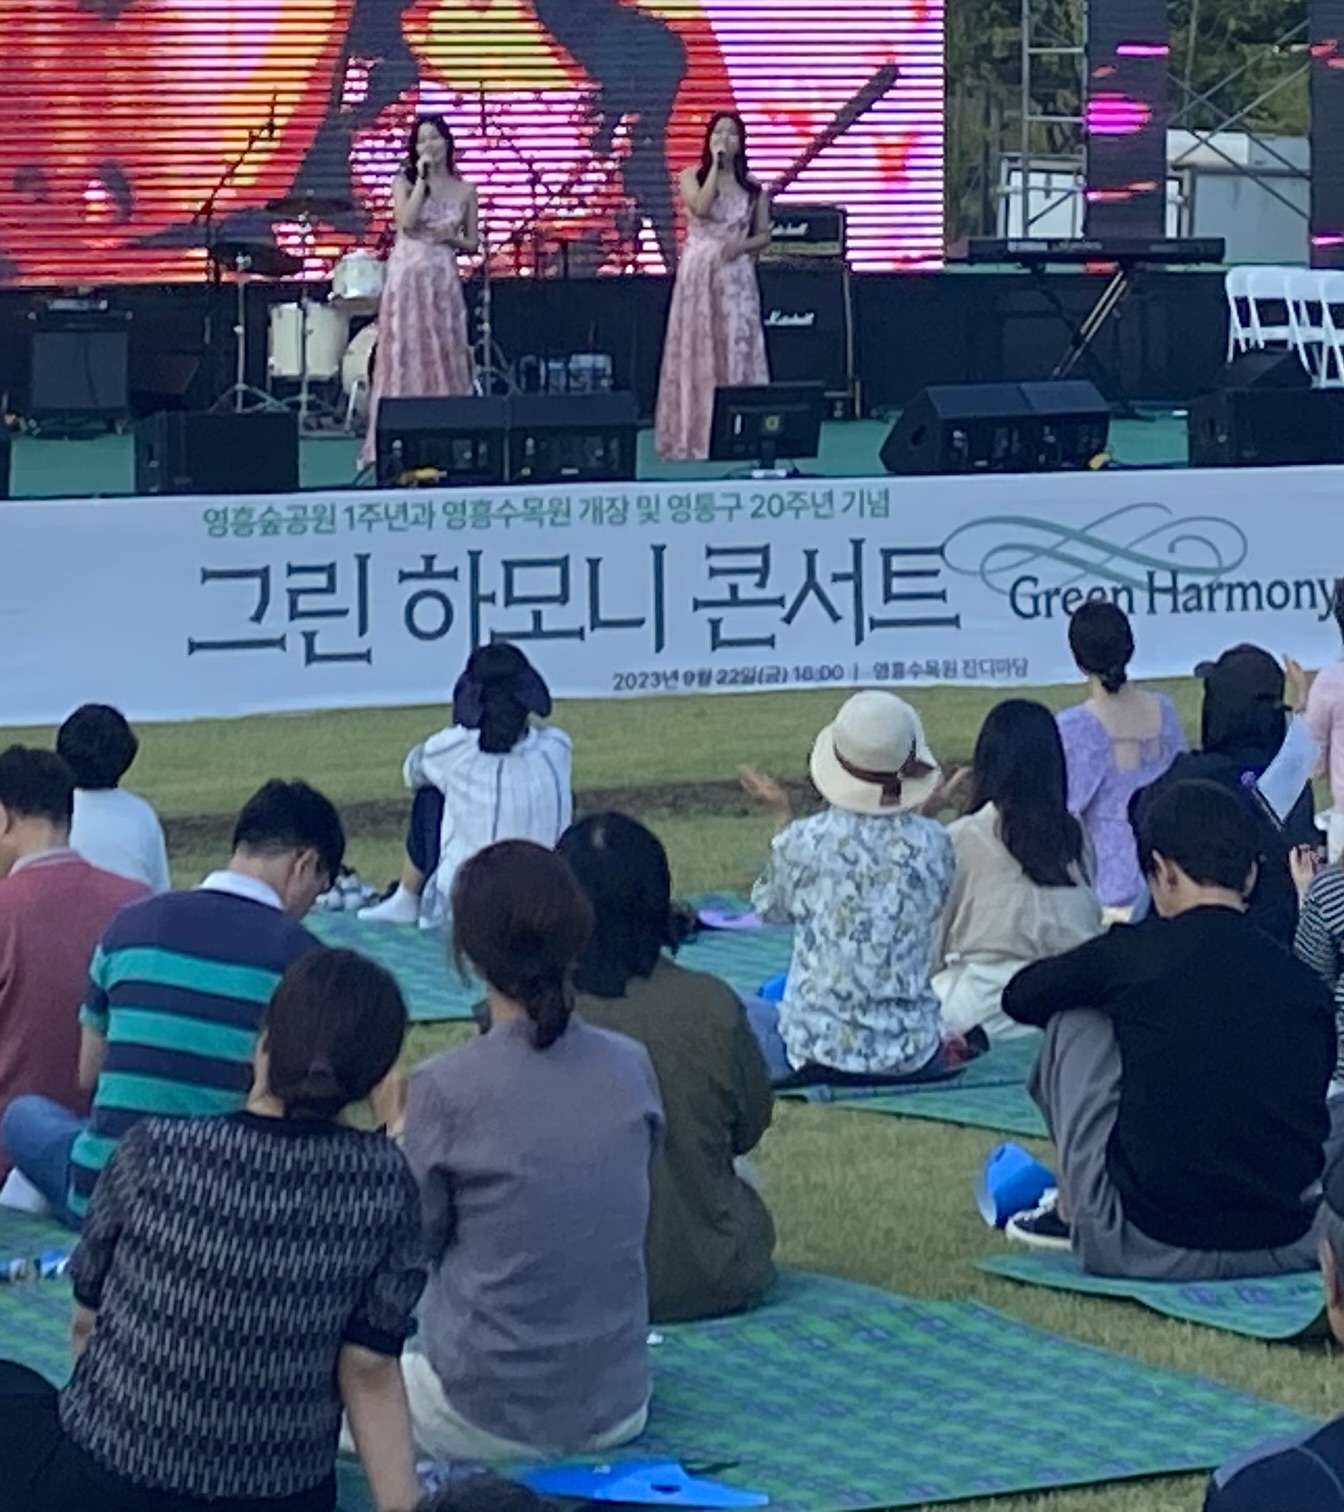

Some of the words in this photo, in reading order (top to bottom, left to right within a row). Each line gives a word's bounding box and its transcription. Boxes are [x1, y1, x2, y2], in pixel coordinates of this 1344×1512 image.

[203, 503, 337, 538] 영흥숲공원
[344, 500, 435, 533] 1주년과
[442, 496, 572, 531] 영흥수목원
[579, 496, 630, 526] 개장
[636, 494, 660, 524] 및
[667, 492, 744, 524] 영통구
[750, 489, 835, 520] 20주년
[841, 487, 890, 519] 기념
[188, 552, 373, 667] 그린
[398, 543, 667, 654] 하모니
[692, 537, 962, 653] 콘서트
[1144, 569, 1340, 623] Harmony
[613, 668, 679, 691] 2023년
